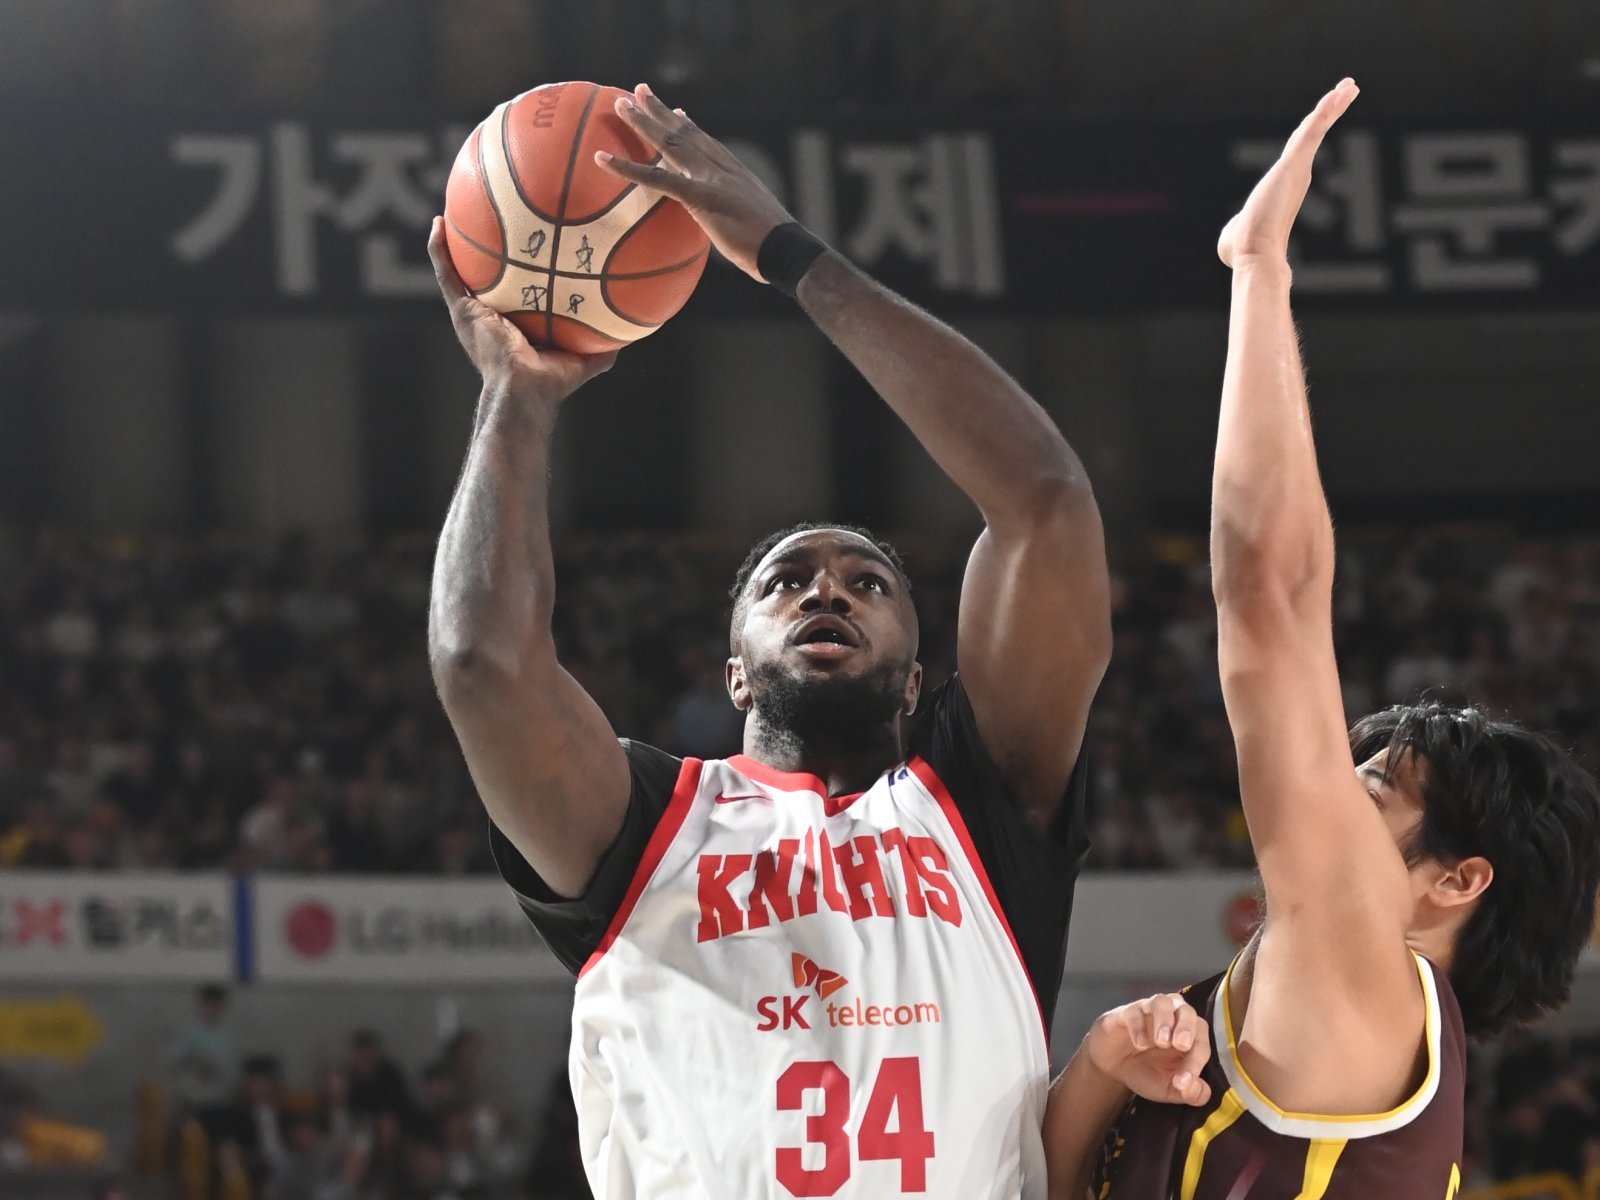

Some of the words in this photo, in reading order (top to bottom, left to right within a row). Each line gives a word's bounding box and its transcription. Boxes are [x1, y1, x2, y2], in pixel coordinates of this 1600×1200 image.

[756, 995, 812, 1032] SK
[826, 997, 941, 1029] telecom
[775, 1056, 936, 1198] 34
